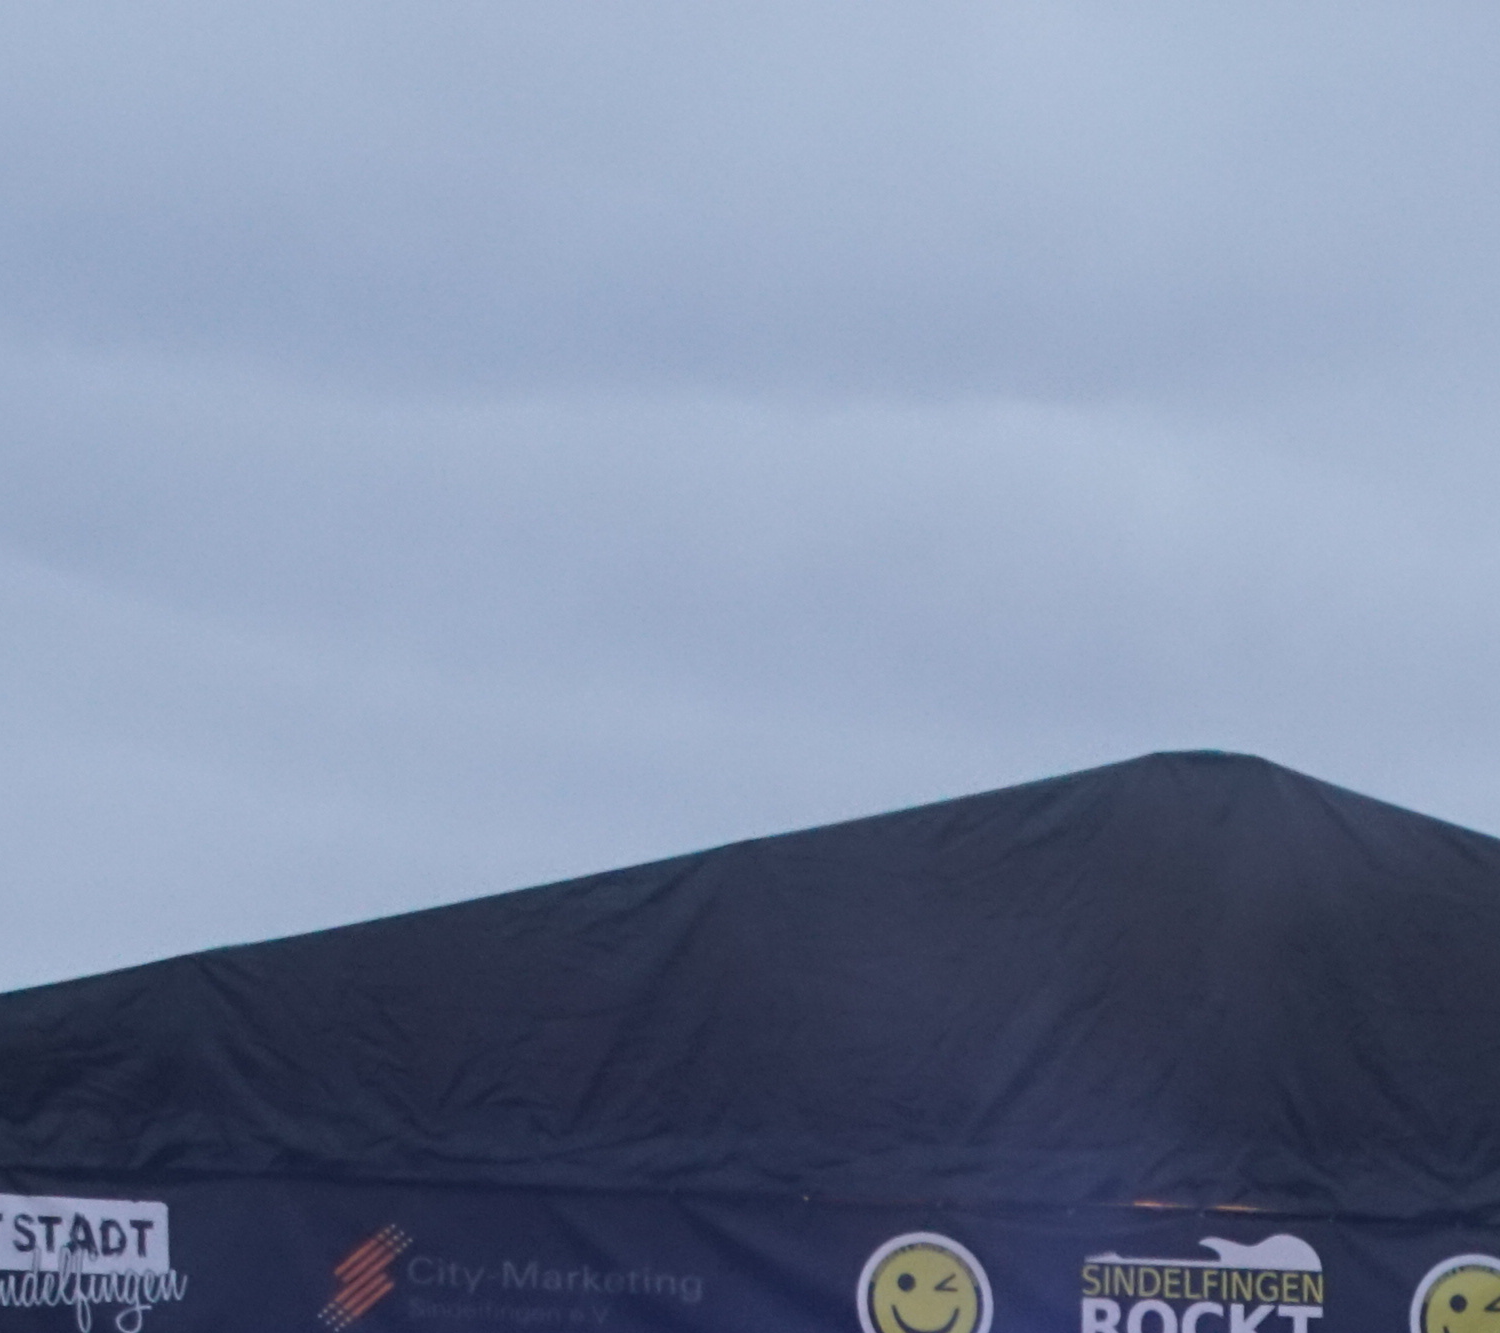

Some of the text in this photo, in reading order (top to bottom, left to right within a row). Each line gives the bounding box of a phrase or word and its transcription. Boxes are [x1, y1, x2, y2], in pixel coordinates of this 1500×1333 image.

[12, 1212, 154, 1258] STADT
[406, 1255, 703, 1304] City-Marketing
[1081, 1265, 1324, 1304] SINDELFINGEN
